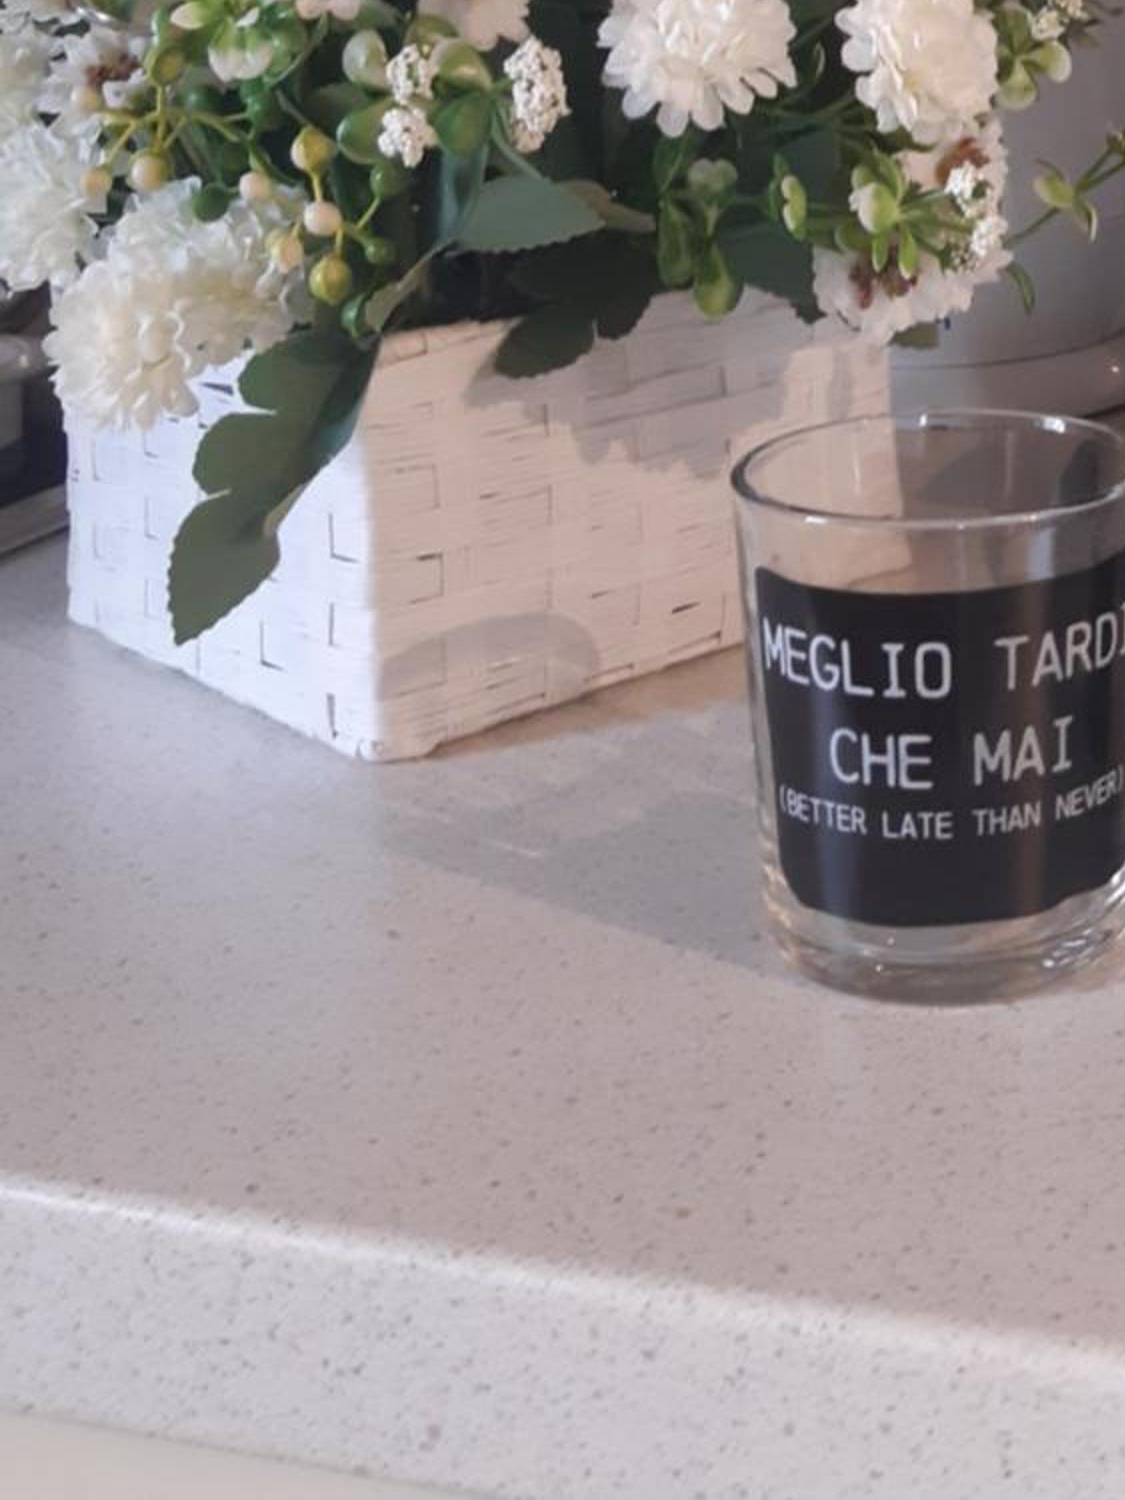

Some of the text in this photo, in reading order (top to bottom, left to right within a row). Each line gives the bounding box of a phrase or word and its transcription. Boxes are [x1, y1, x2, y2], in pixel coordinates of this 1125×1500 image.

[762, 616, 952, 699] MEGLIO
[829, 715, 1073, 790] CHE MAI
[779, 763, 1125, 840] (BETTER LATE THAN NEVER)
